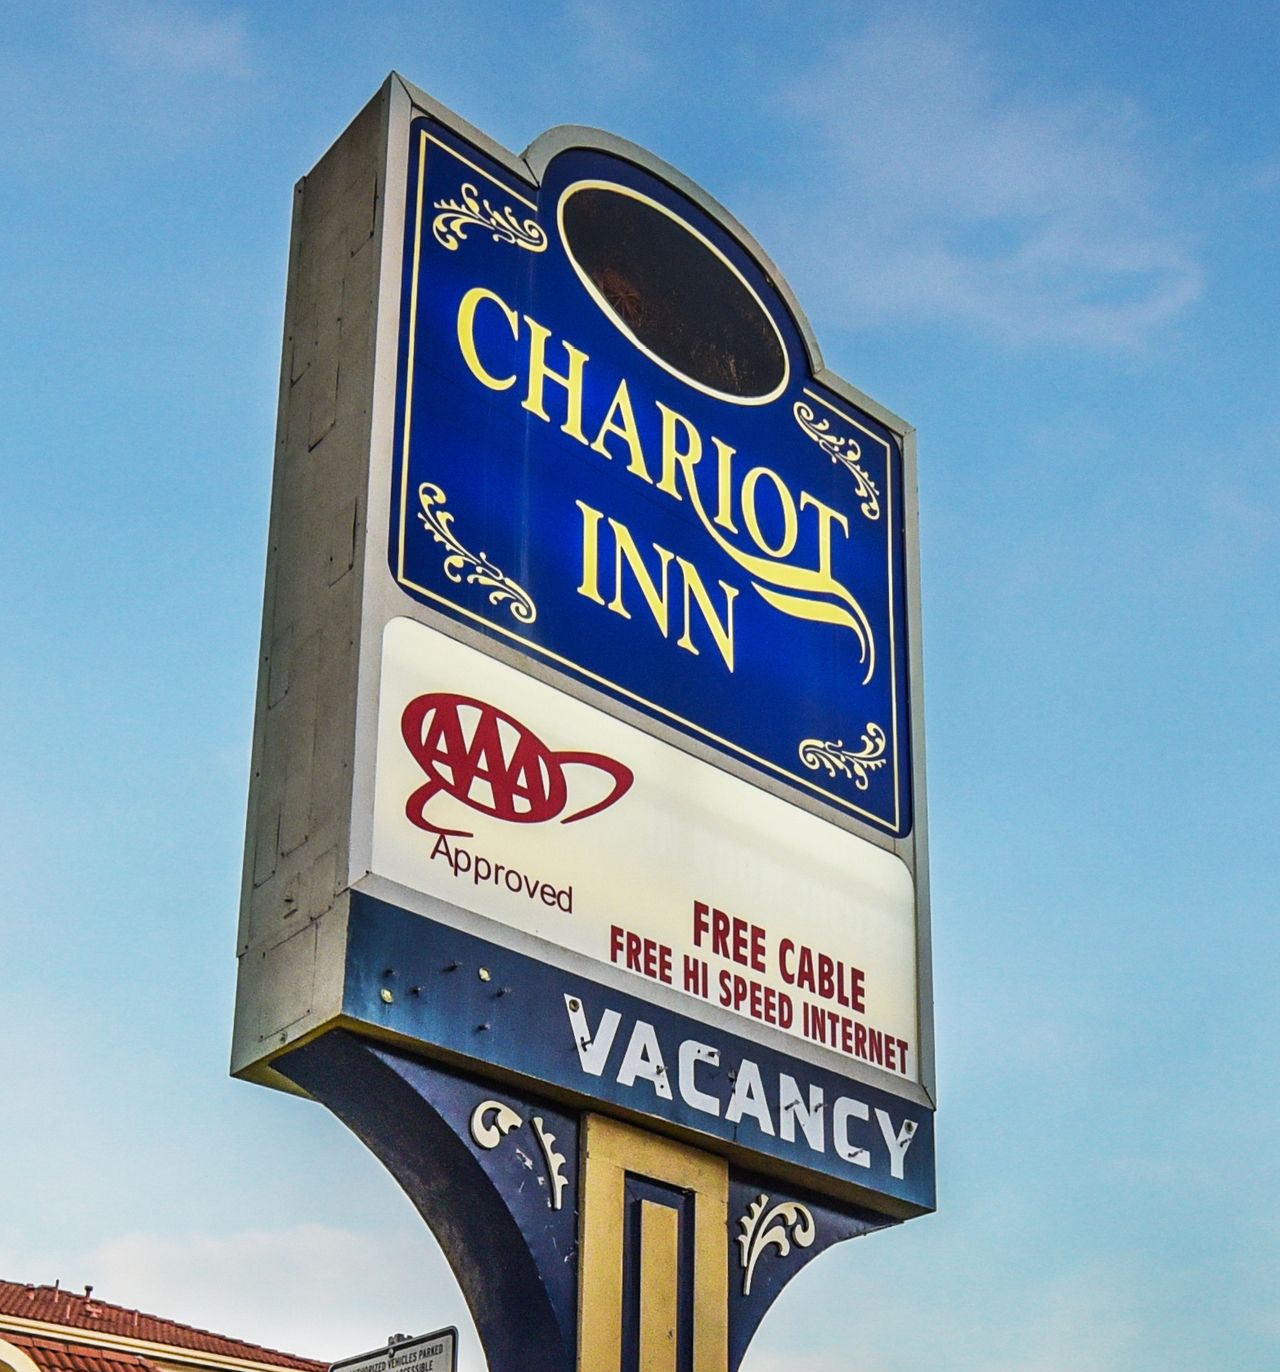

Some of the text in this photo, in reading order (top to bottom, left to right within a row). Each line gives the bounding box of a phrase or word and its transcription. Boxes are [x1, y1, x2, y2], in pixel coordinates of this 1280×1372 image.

[457, 287, 875, 685] CHARIOT
[576, 500, 739, 673] INN
[401, 693, 567, 823] AAA
[430, 834, 573, 914] Approved
[610, 925, 909, 1074] FREE HI SPEED INTERNET
[694, 900, 866, 1014] FREE CABLE
[563, 993, 919, 1180] VACANCY
[387, 1351, 417, 1369] VEHICLES
[418, 1343, 443, 1360] PARKED
